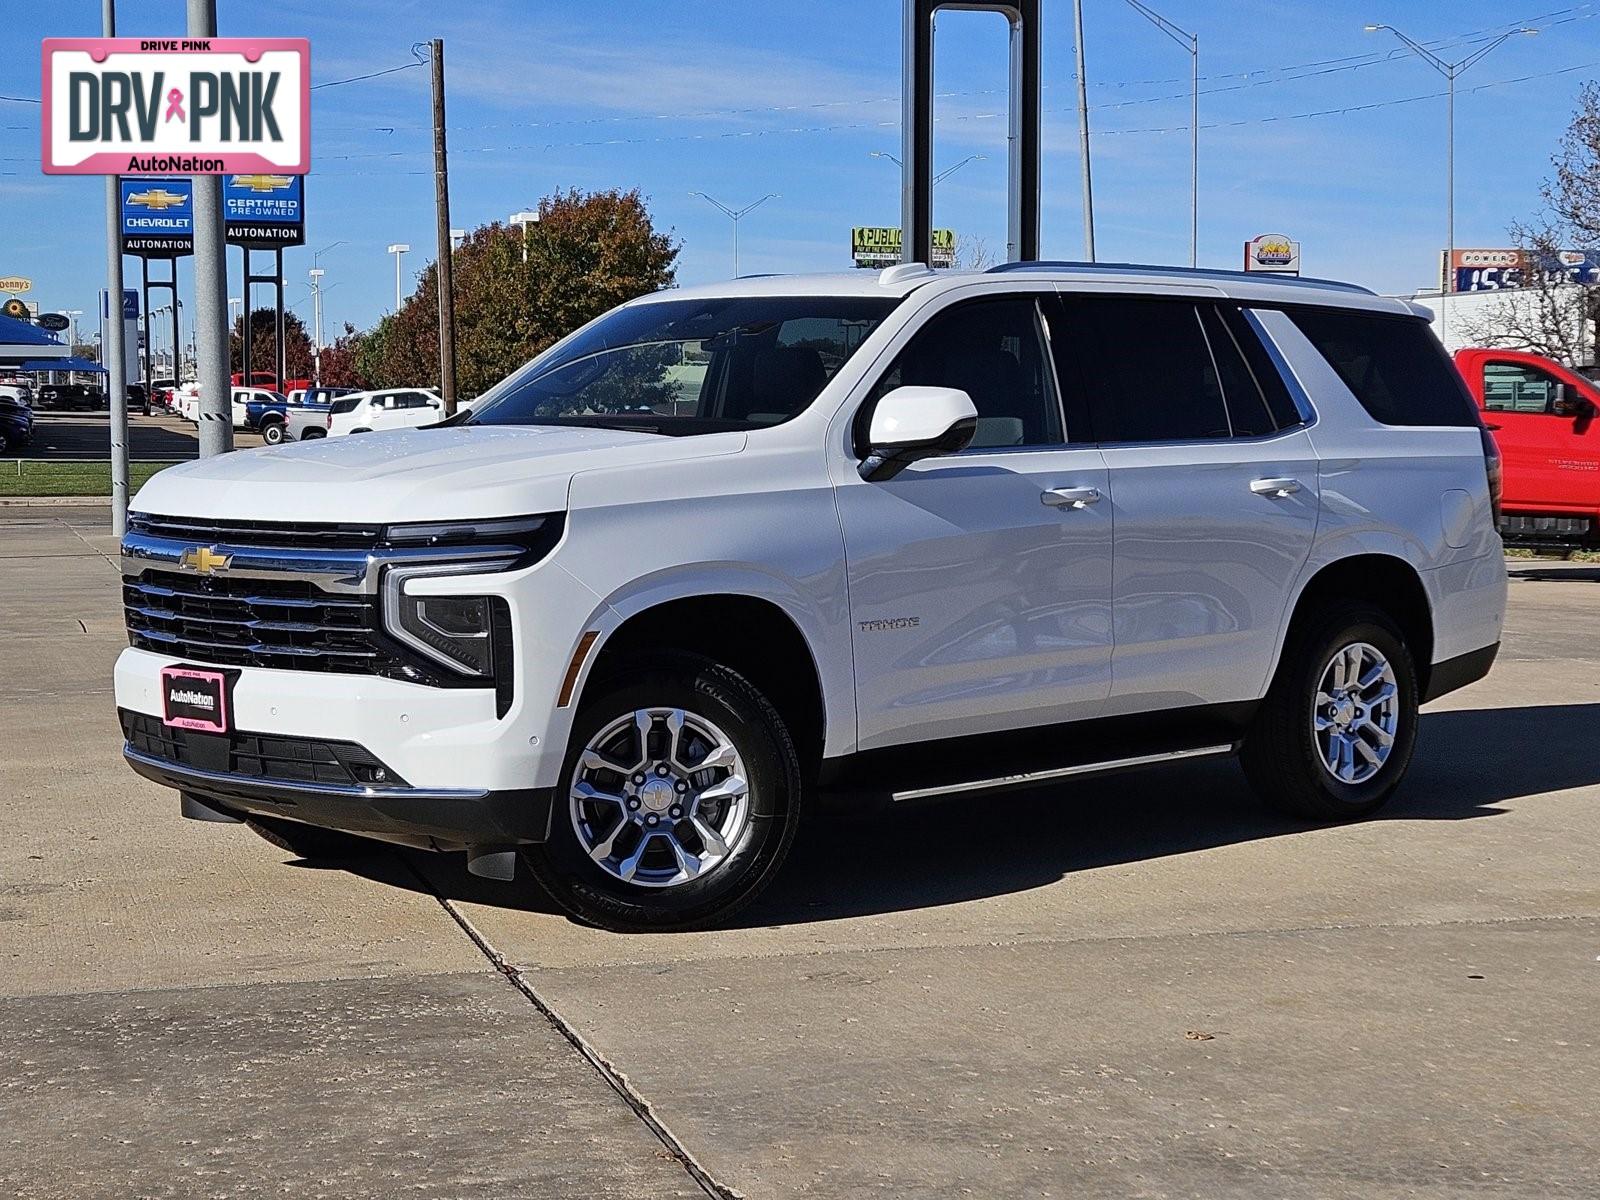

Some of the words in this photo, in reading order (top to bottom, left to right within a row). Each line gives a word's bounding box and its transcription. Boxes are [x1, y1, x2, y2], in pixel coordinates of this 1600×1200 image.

[227, 199, 298, 208] CERTIFIED
[231, 207, 294, 216] PRE-OWNED
[126, 218, 190, 228] CHEVROLET
[227, 227, 298, 238] AUTONATION
[127, 239, 192, 249] AUTONATION
[0, 281, 30, 289] Denny's
[858, 617, 920, 632] TAHOE
[170, 689, 214, 705] AutoNation
[182, 720, 206, 729] AutoNation
